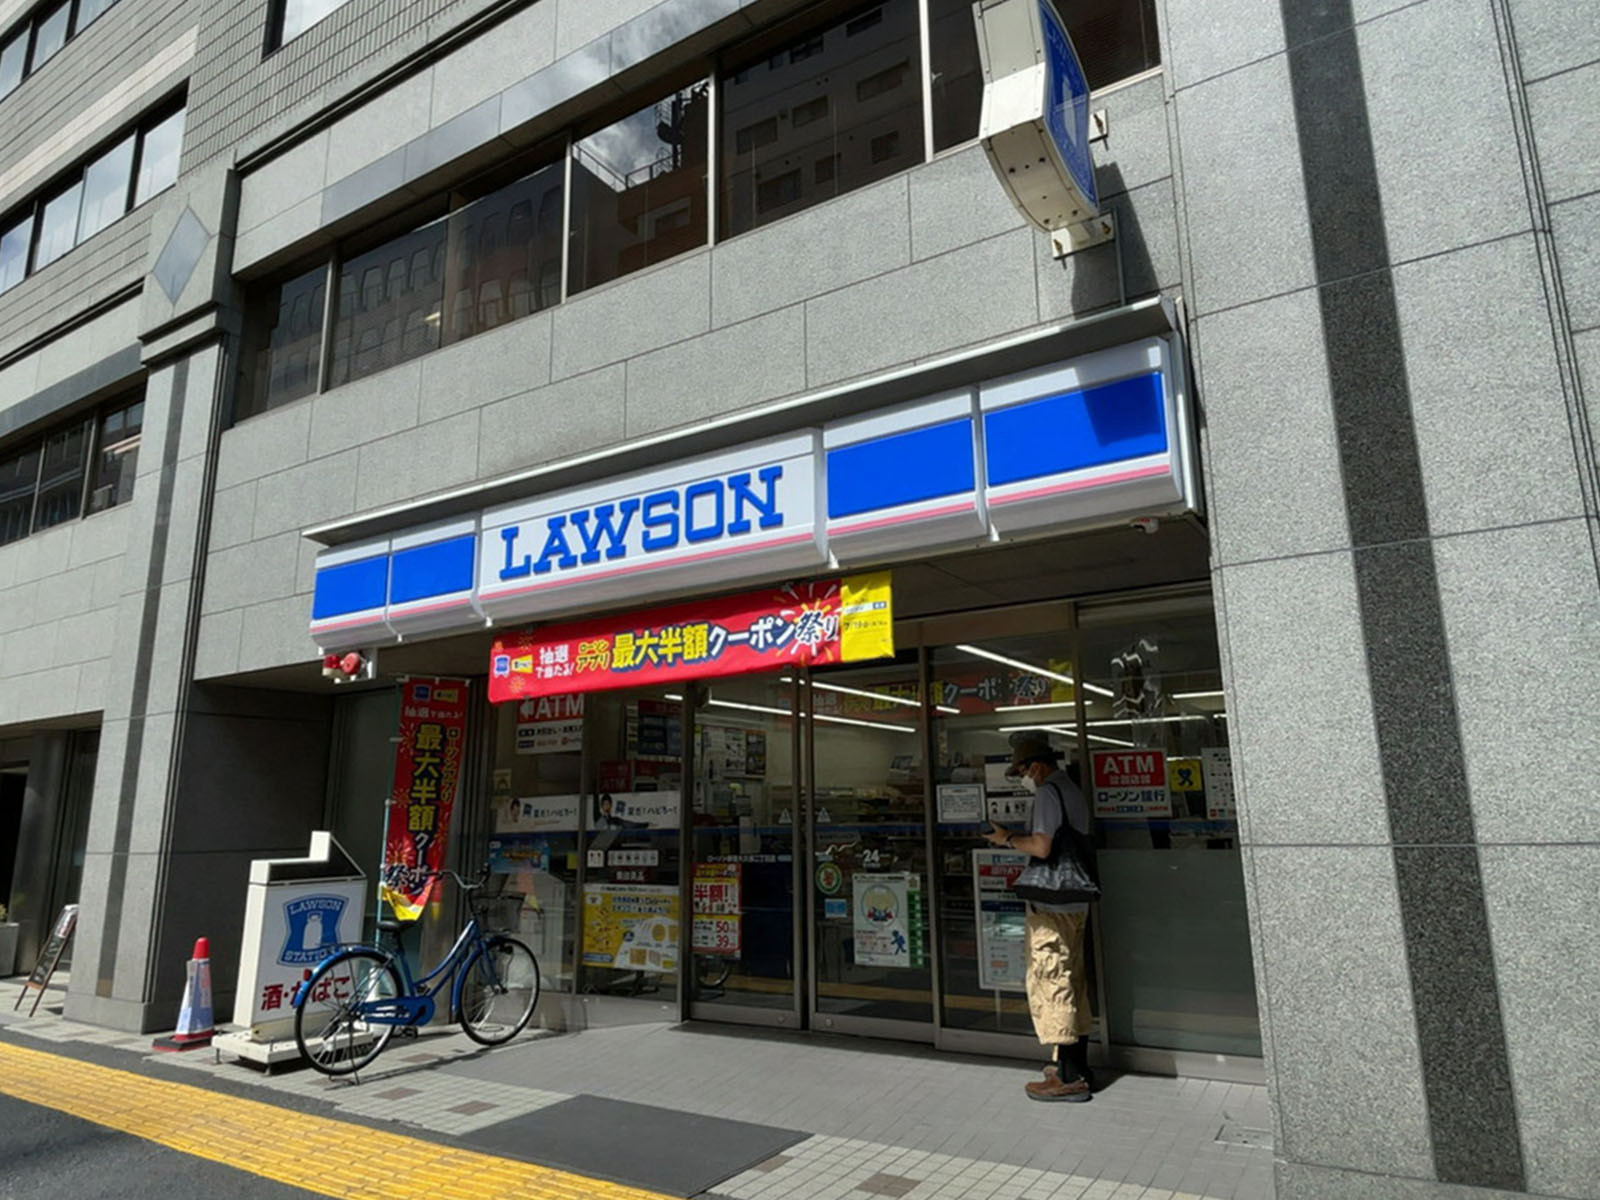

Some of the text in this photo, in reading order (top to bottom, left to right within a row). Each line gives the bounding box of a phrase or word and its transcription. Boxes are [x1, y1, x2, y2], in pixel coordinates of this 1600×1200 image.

[499, 465, 783, 580] LAWSON
[539, 645, 569, 665] 抽選
[578, 639, 609, 653] ローソン
[576, 654, 611, 673] アプリ
[535, 692, 584, 719] ATM
[1103, 755, 1155, 775] ATM
[1097, 790, 1165, 802] ローソン銀行
[289, 898, 343, 916] LAWSON
